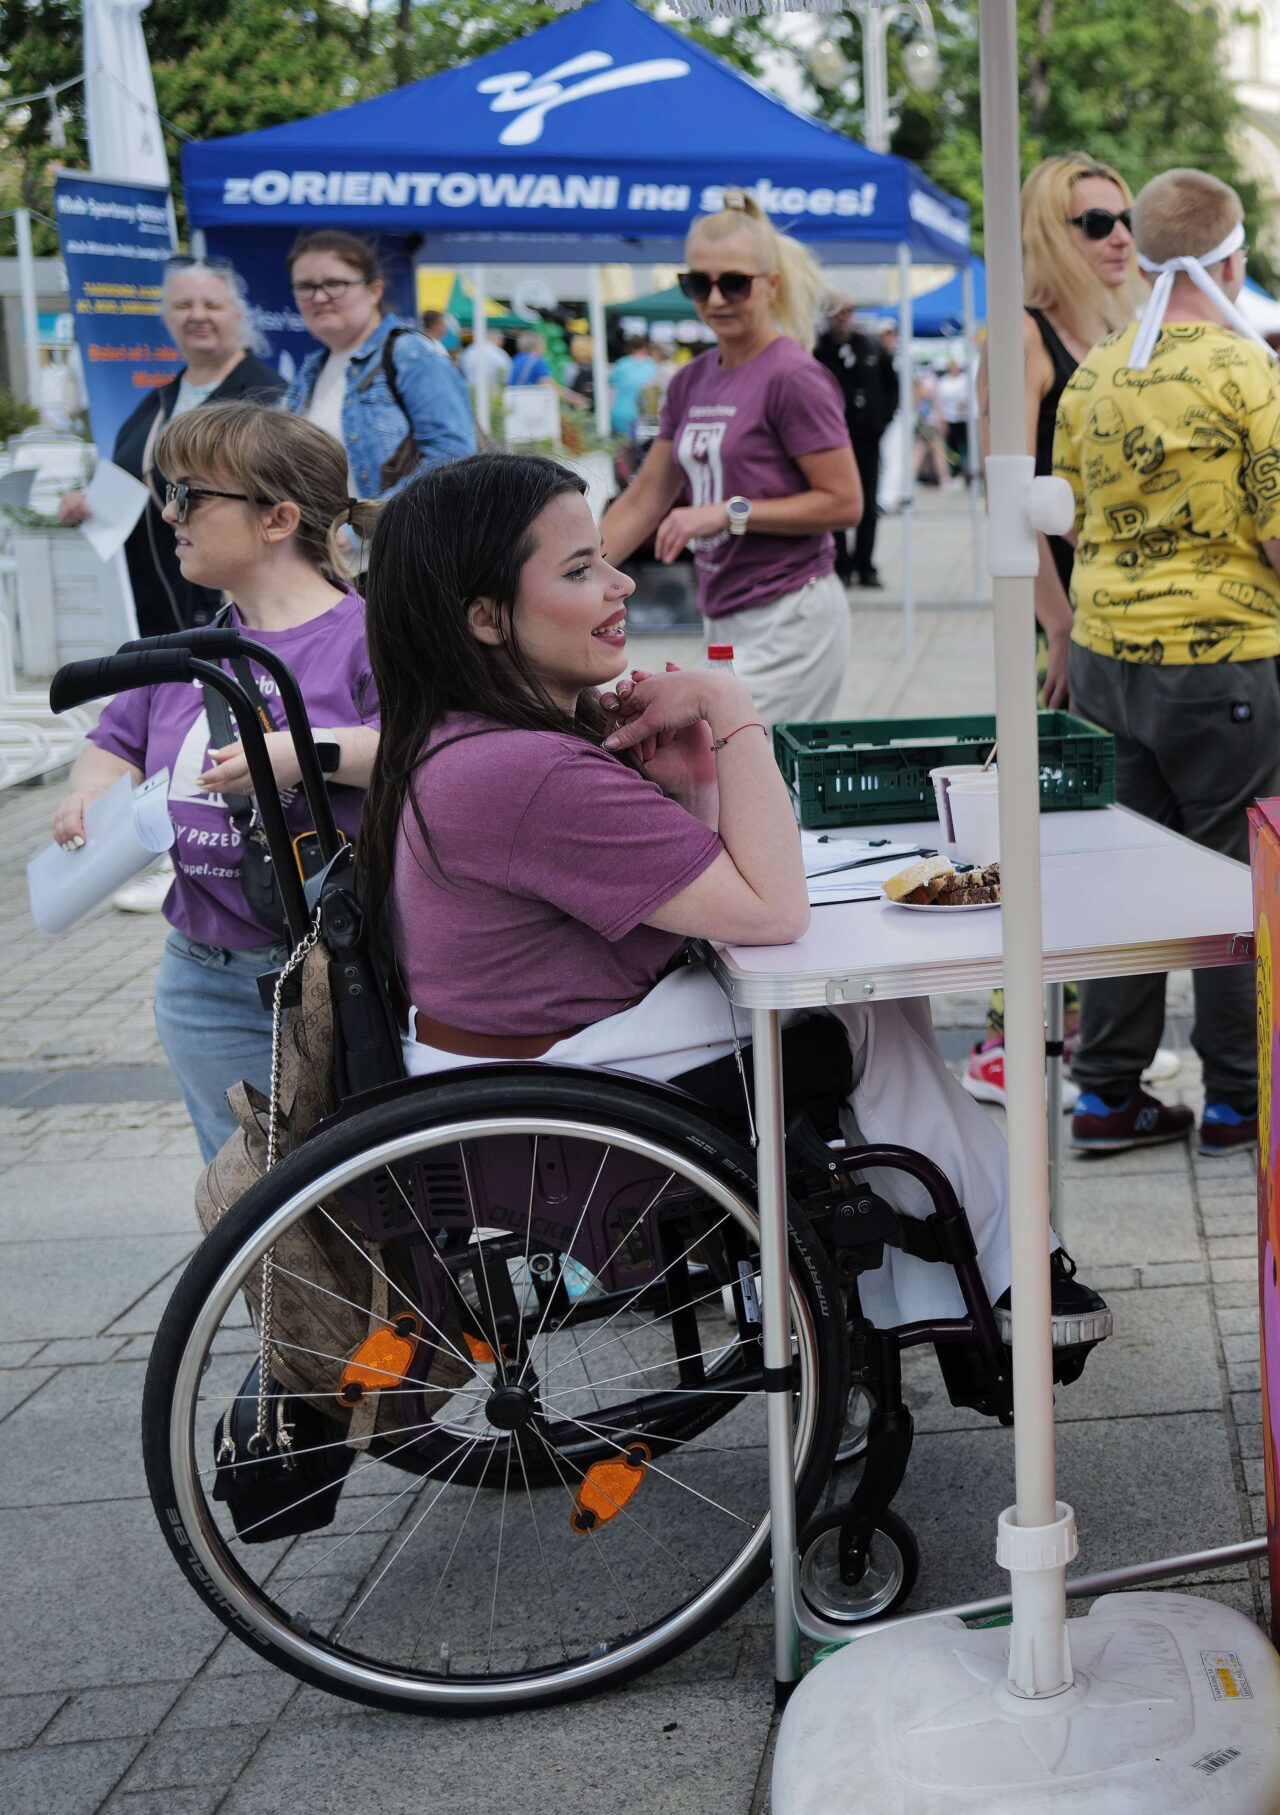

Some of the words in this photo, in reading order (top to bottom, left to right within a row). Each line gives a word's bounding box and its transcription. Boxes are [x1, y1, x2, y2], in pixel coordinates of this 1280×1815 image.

[223, 169, 620, 210] zORIENTOWANI
[627, 181, 692, 211] na
[698, 178, 878, 217] skces!
[166, 1507, 271, 1646] SCHWALBE
